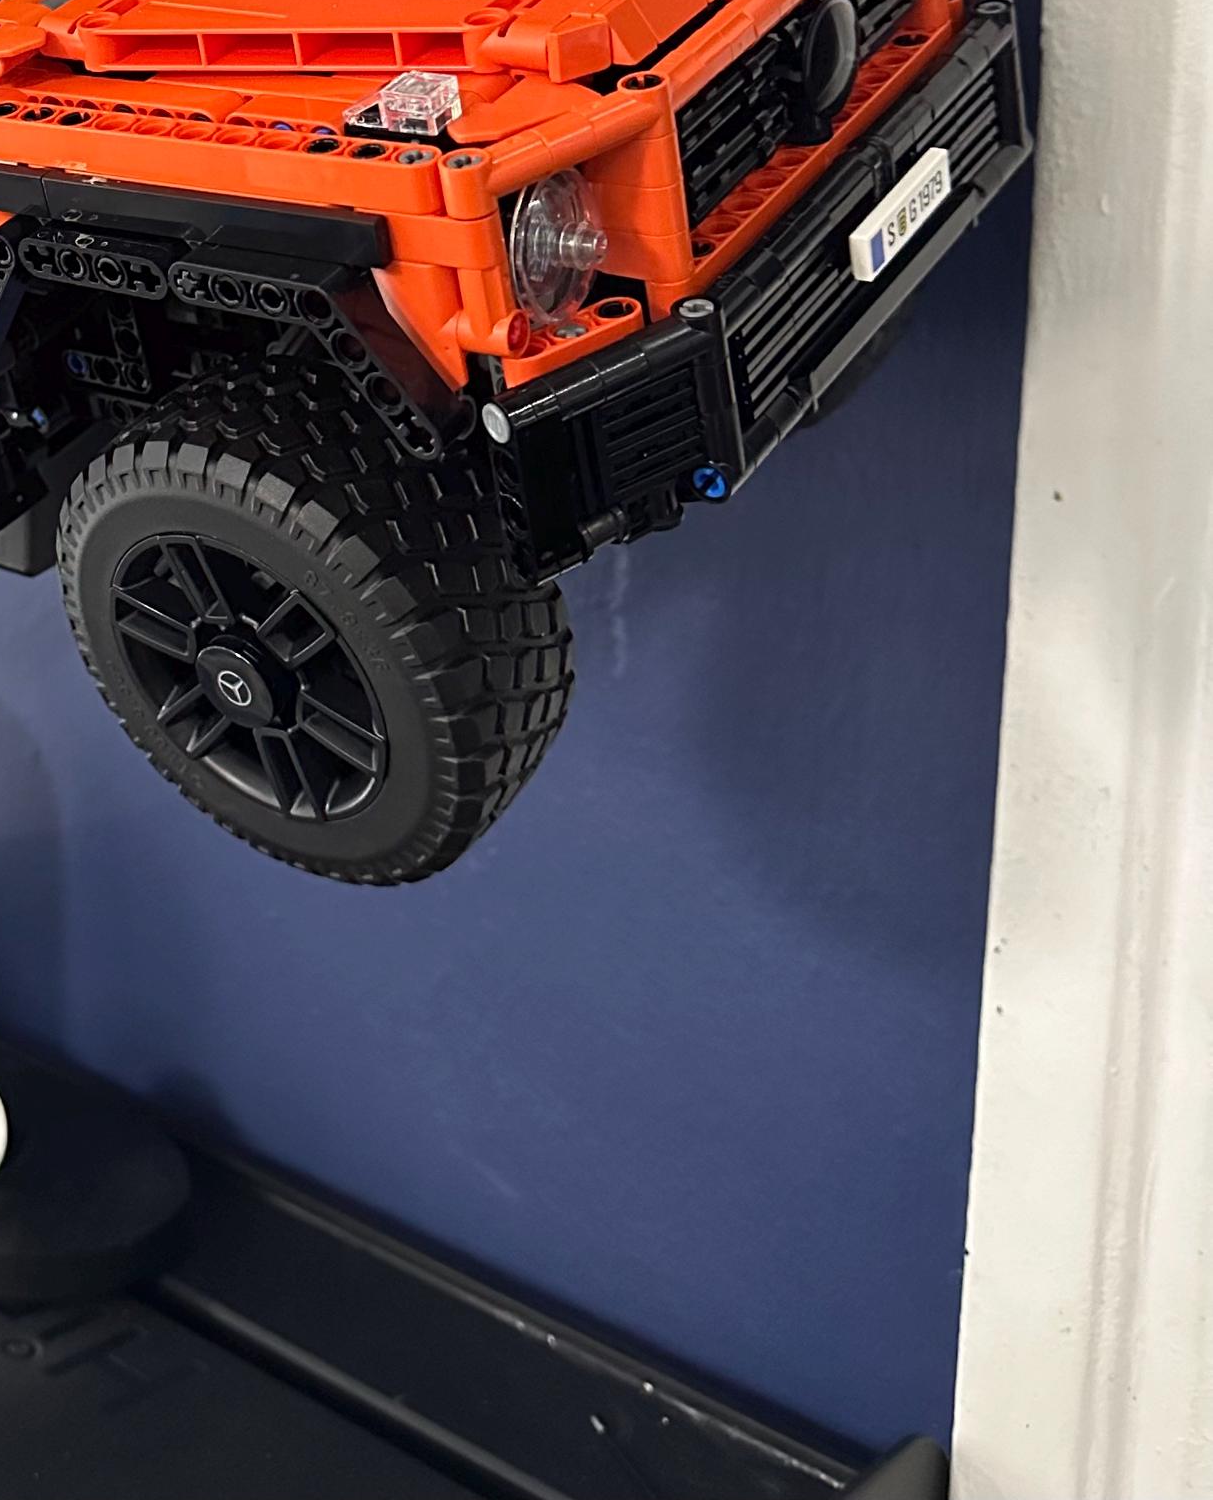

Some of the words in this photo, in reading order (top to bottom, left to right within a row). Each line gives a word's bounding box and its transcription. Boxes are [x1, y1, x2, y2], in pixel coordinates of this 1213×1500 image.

[887, 222, 896, 247] S
[908, 199, 917, 223] G
[918, 170, 943, 212] 1979
